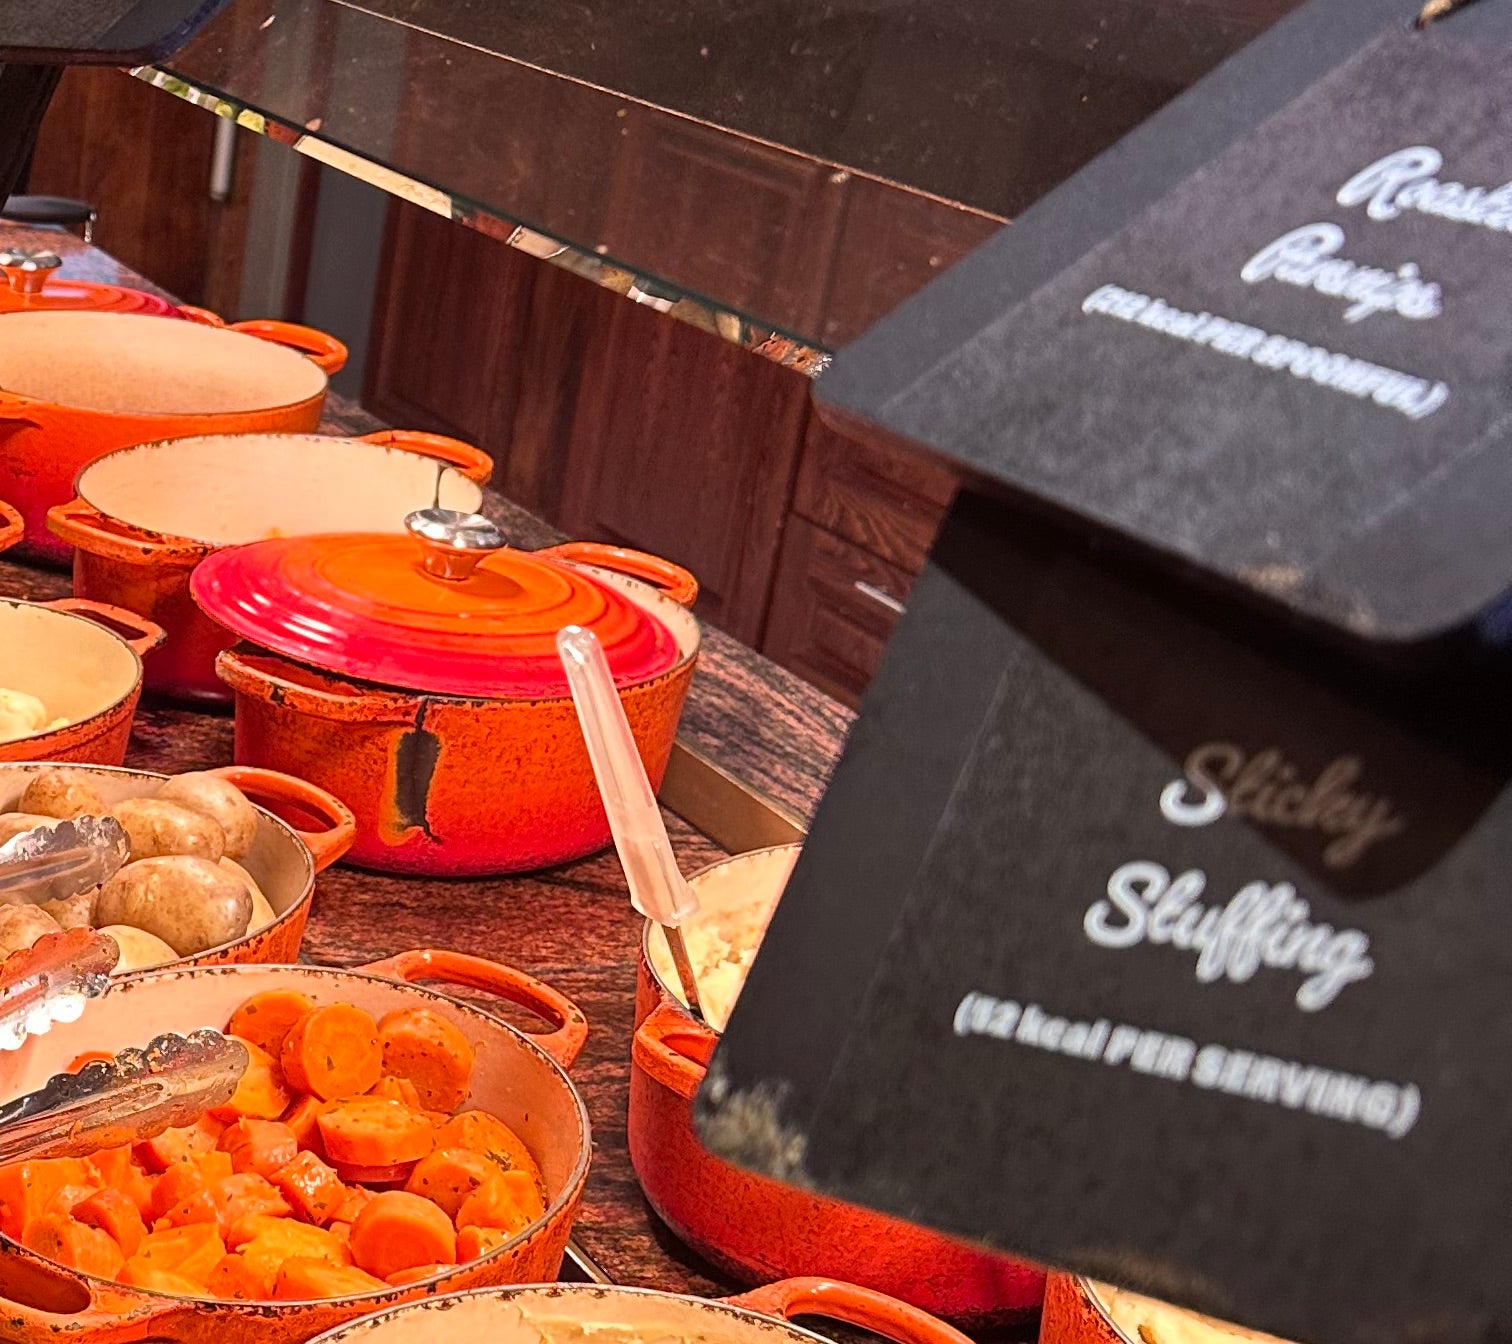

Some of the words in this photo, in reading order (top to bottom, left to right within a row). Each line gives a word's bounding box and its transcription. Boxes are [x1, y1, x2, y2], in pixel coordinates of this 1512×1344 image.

[1159, 742, 1404, 868] Sticky
[1083, 860, 1375, 1012] Stuffing
[1102, 1022, 1198, 1081] PER
[1191, 1043, 1422, 1140] SERVING)
